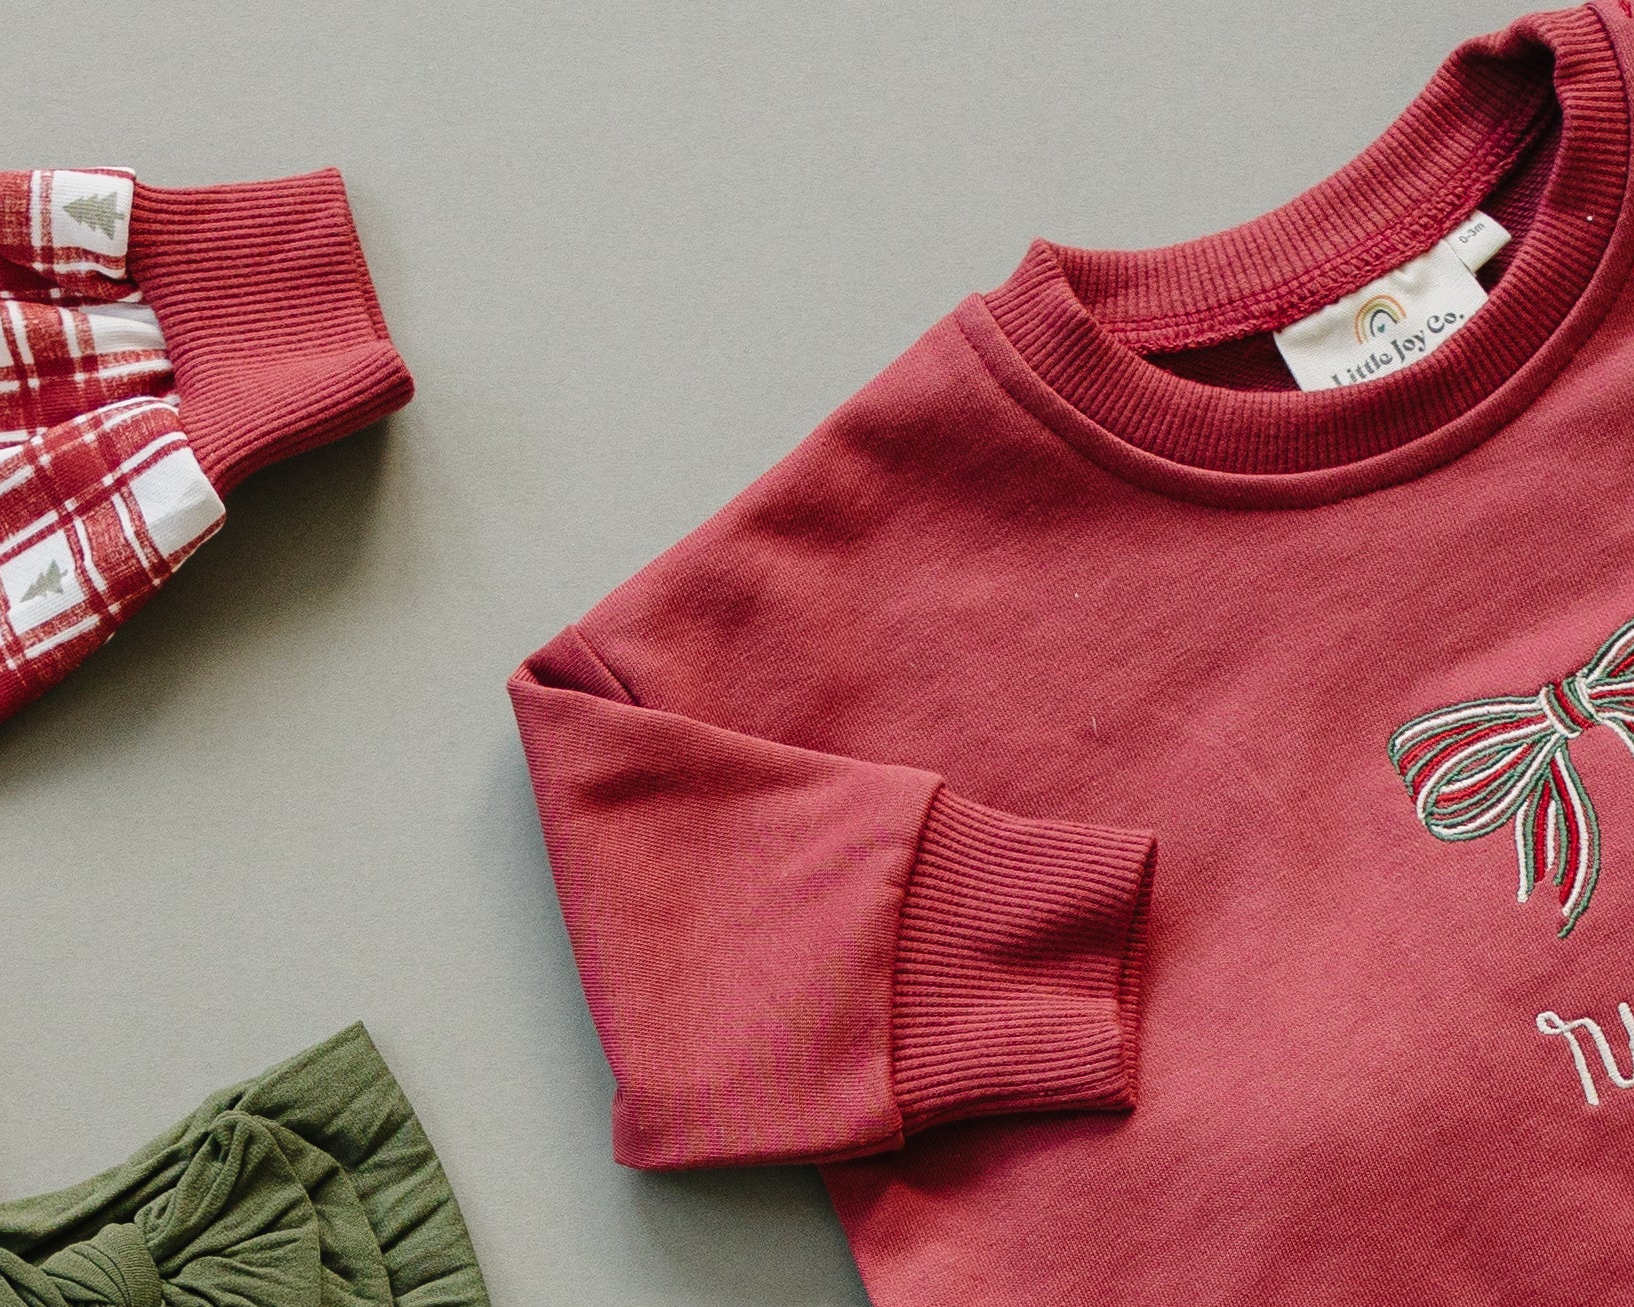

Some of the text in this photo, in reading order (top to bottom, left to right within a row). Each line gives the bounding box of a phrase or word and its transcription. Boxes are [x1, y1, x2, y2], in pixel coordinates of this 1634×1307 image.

[1458, 222, 1486, 244] 0-3m
[1390, 329, 1426, 363] Joy
[1426, 312, 1465, 334] Co.
